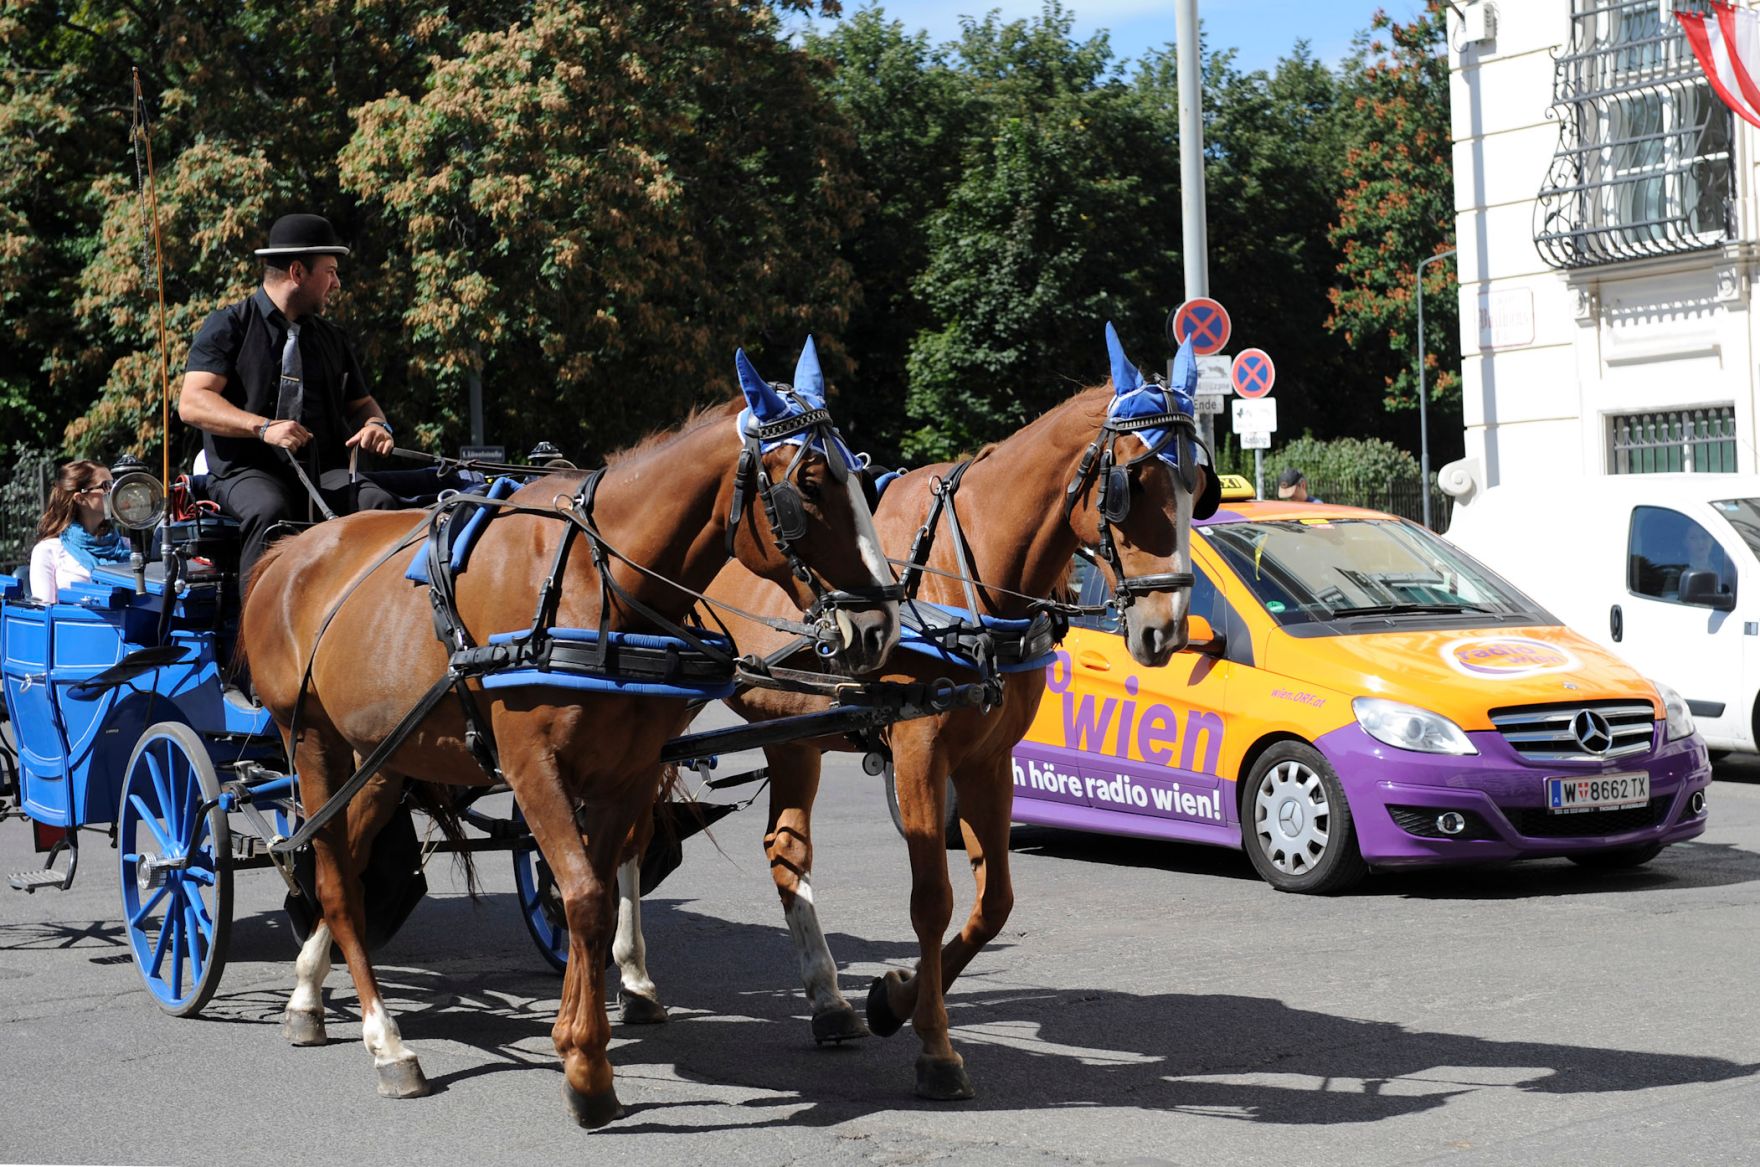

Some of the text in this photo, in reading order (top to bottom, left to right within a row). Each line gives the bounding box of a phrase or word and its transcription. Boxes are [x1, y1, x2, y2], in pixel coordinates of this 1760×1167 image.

[1194, 399, 1217, 410] Ende
[1062, 675, 1224, 774] wien
[1028, 760, 1083, 797] höre
[1085, 774, 1148, 807] radio
[1151, 783, 1221, 820] wien!
